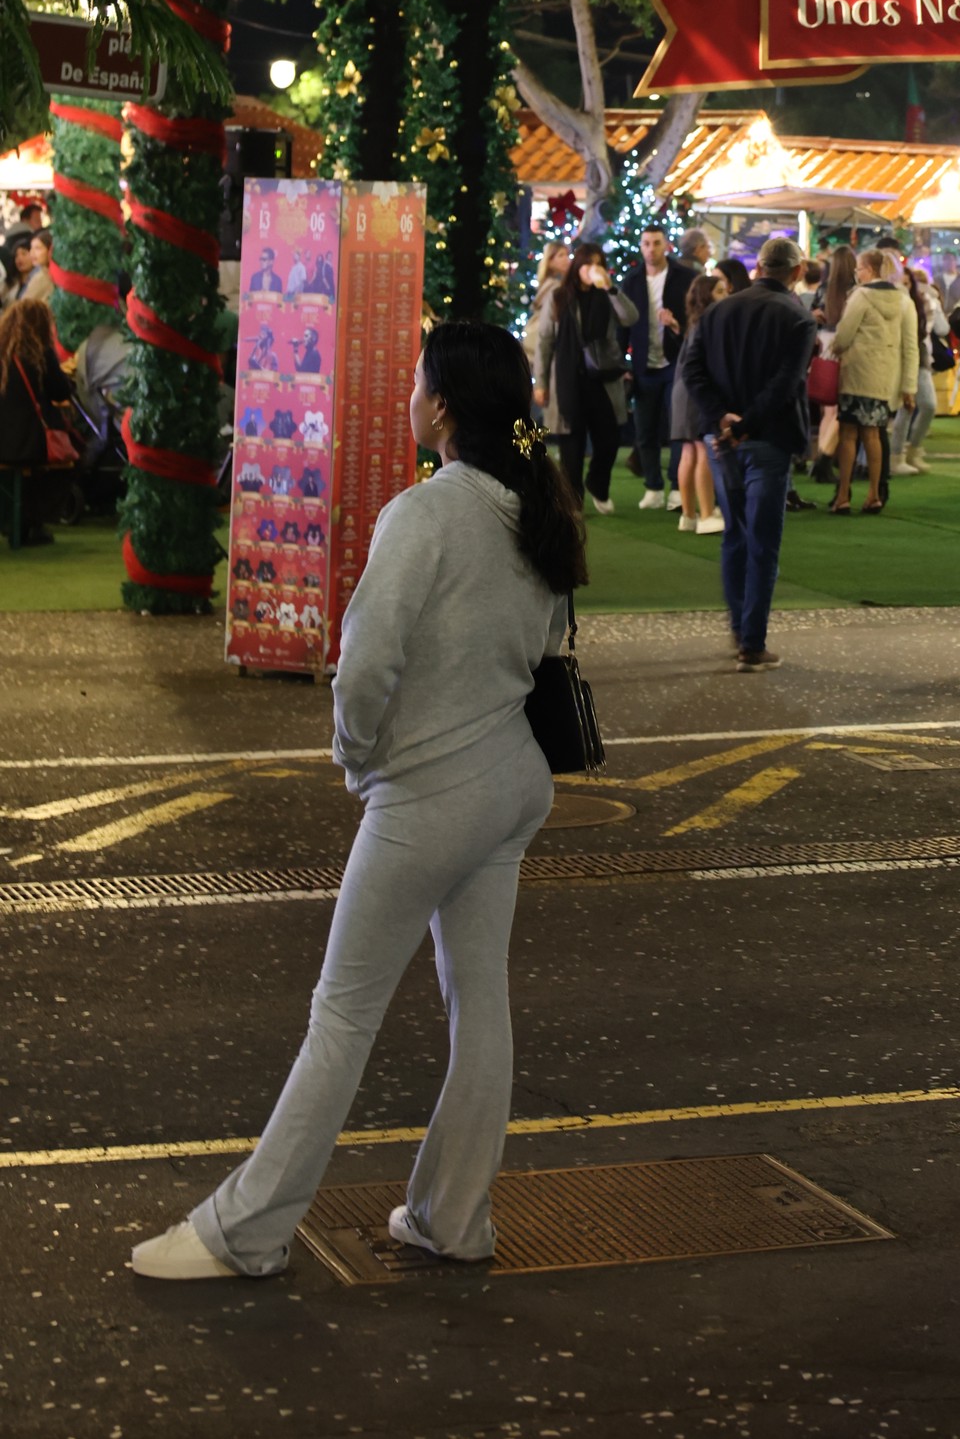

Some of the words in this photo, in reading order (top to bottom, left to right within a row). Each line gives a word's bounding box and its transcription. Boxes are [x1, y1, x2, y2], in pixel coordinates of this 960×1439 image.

[61, 61, 83, 83] De
[310, 211, 325, 233] 06
[400, 213, 413, 234] 06
